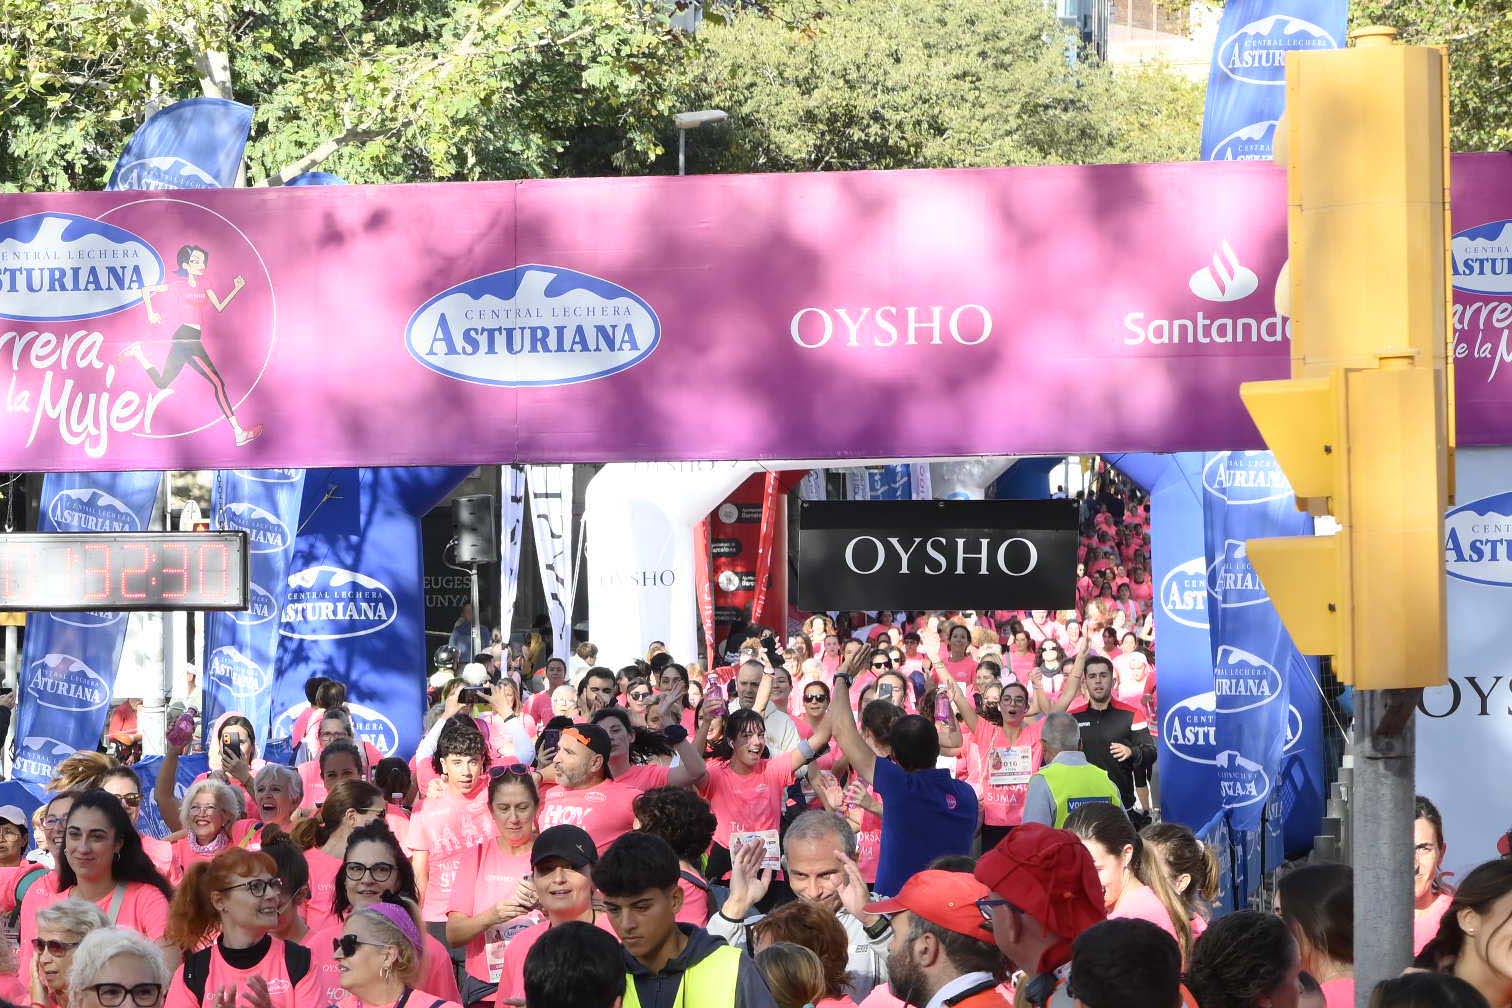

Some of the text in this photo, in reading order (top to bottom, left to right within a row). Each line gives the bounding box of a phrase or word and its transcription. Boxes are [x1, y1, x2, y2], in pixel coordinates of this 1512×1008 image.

[68, 247, 140, 260] LECHERA
[464, 305, 633, 320] CENTRAL LECHERA
[791, 304, 993, 349] OYSHO
[426, 312, 641, 357] ASTURIANA
[6, 375, 30, 414] la
[26, 367, 174, 457] Mujer
[844, 535, 1039, 576] OYSHO
